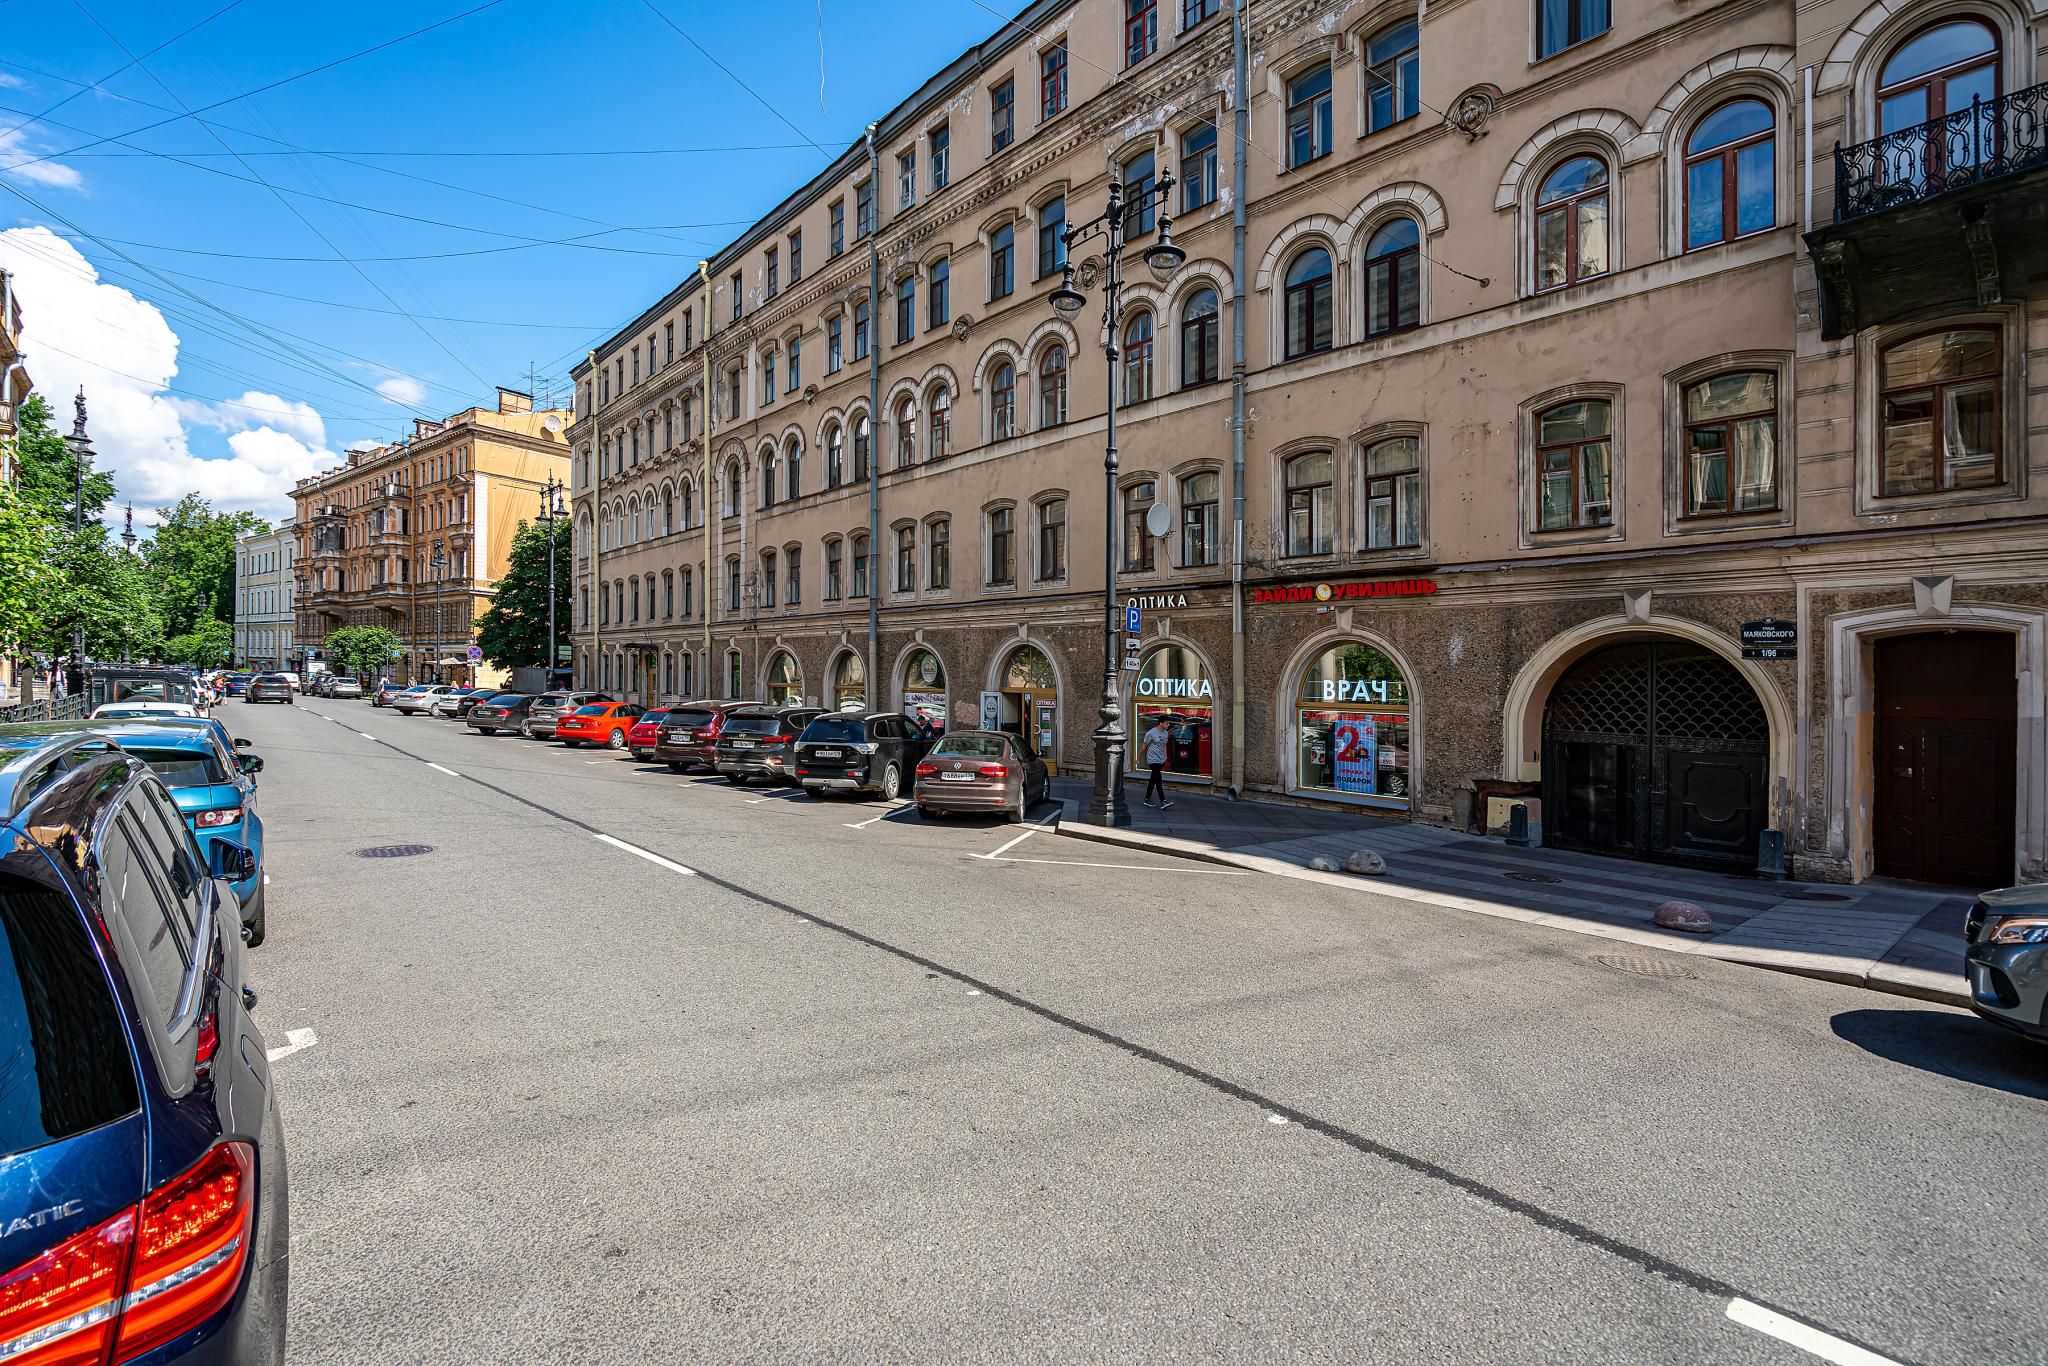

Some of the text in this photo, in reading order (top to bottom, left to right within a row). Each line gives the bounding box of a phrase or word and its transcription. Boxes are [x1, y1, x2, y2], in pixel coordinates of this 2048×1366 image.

[1254, 579, 1437, 602] ЗАЙДИ УВИДИШЬ
[1128, 595, 1187, 609] ОПТИКА
[1762, 649, 1777, 657] 1/96
[1139, 678, 1212, 698] ОПТИКА
[1323, 679, 1387, 702] ВРАЧ
[1336, 725, 1360, 763] 2
[1337, 775, 1372, 785] ПОДАРОК
